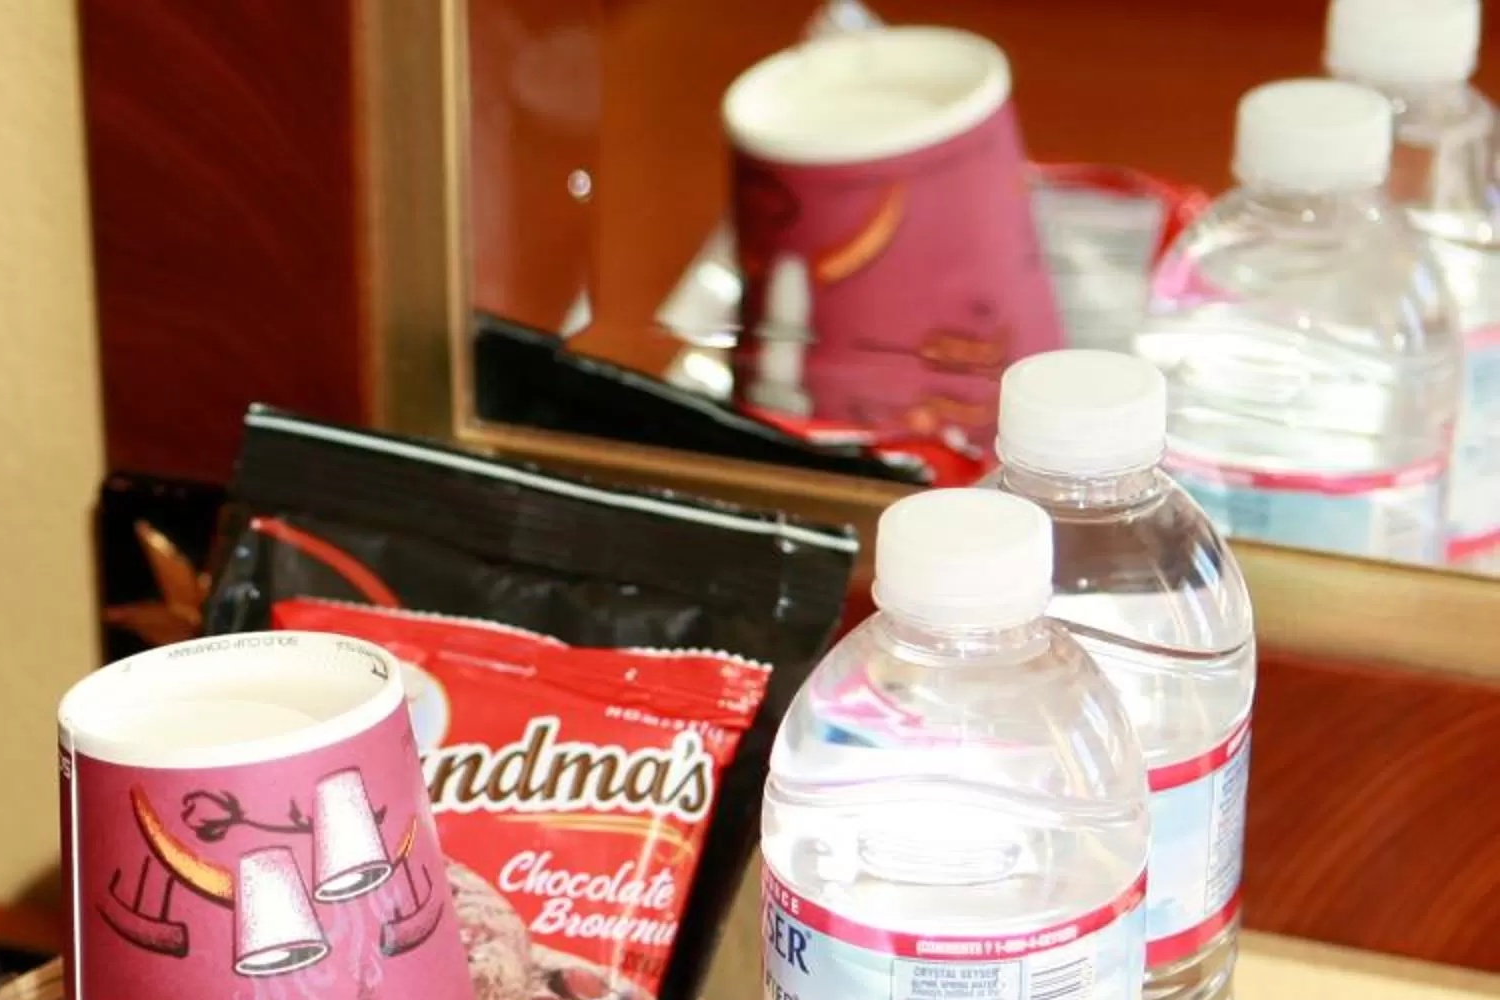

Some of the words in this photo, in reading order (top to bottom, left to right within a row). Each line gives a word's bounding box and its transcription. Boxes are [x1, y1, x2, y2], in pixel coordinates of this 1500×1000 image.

[421, 722, 713, 814] ndma's
[499, 850, 676, 910] Chocolate
[530, 897, 677, 946] Browni
